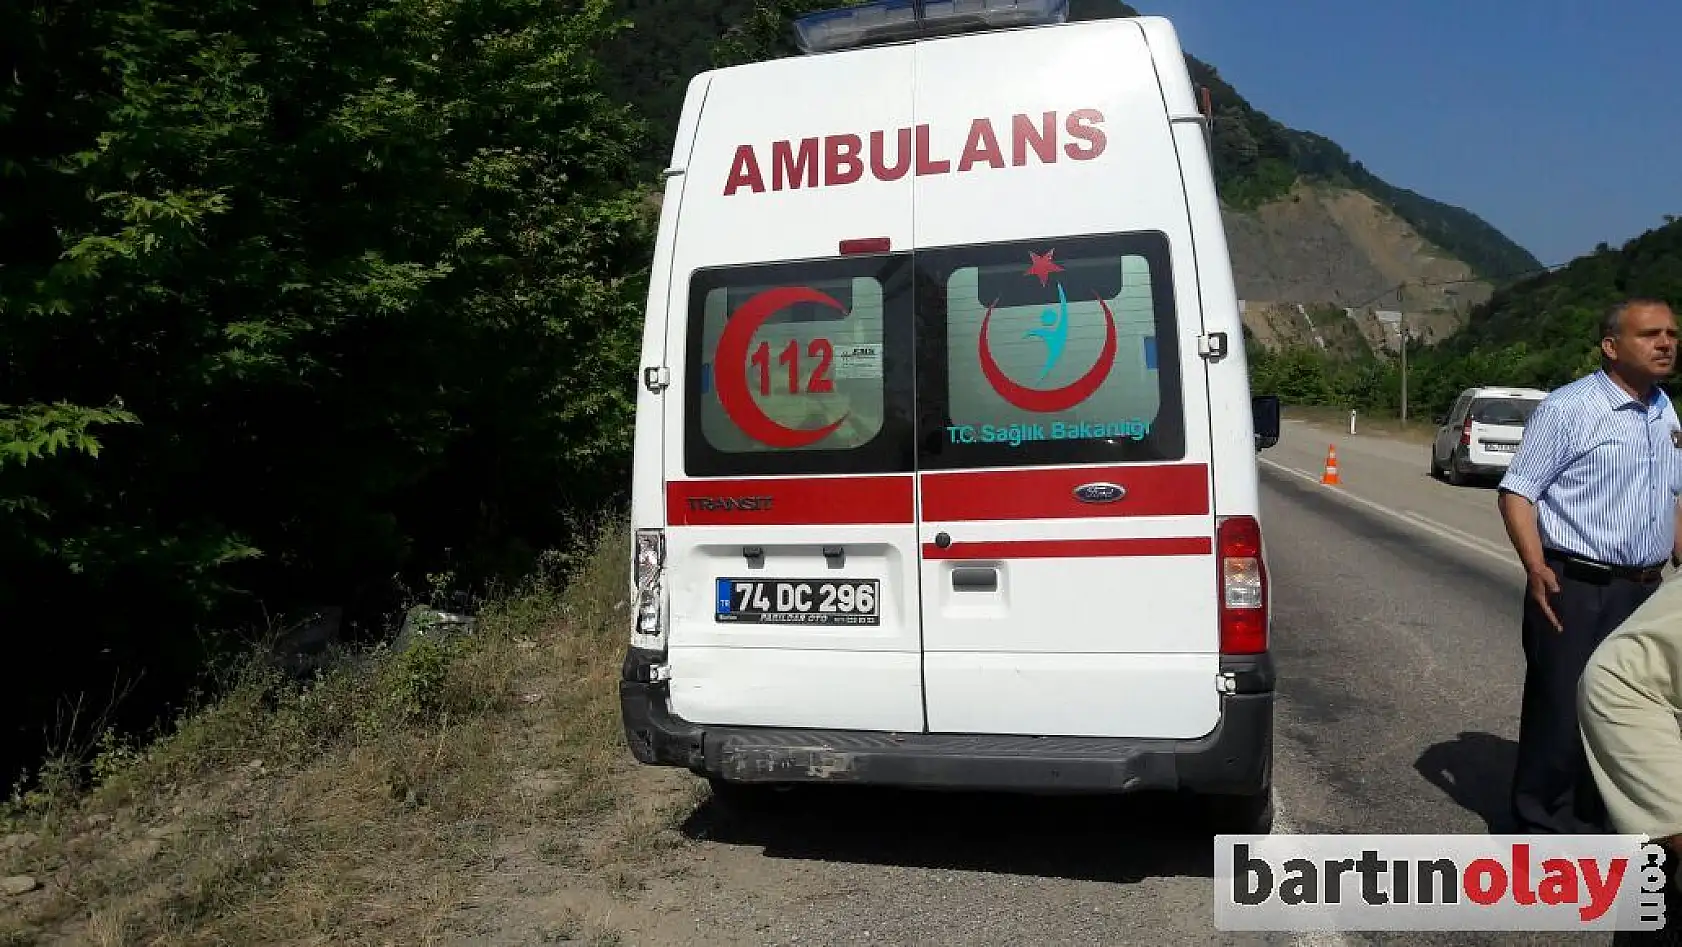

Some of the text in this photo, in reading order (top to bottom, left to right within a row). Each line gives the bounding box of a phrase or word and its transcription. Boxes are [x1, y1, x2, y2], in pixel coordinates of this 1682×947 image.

[723, 108, 1108, 197] AMBULANS
[751, 338, 835, 396] 112
[981, 422, 1045, 446] Sağlık
[1051, 417, 1151, 441] Bakanlığı
[687, 496, 773, 511] TRANSIT
[735, 582, 771, 612] 74
[776, 583, 813, 612] DC
[818, 583, 876, 613] 296
